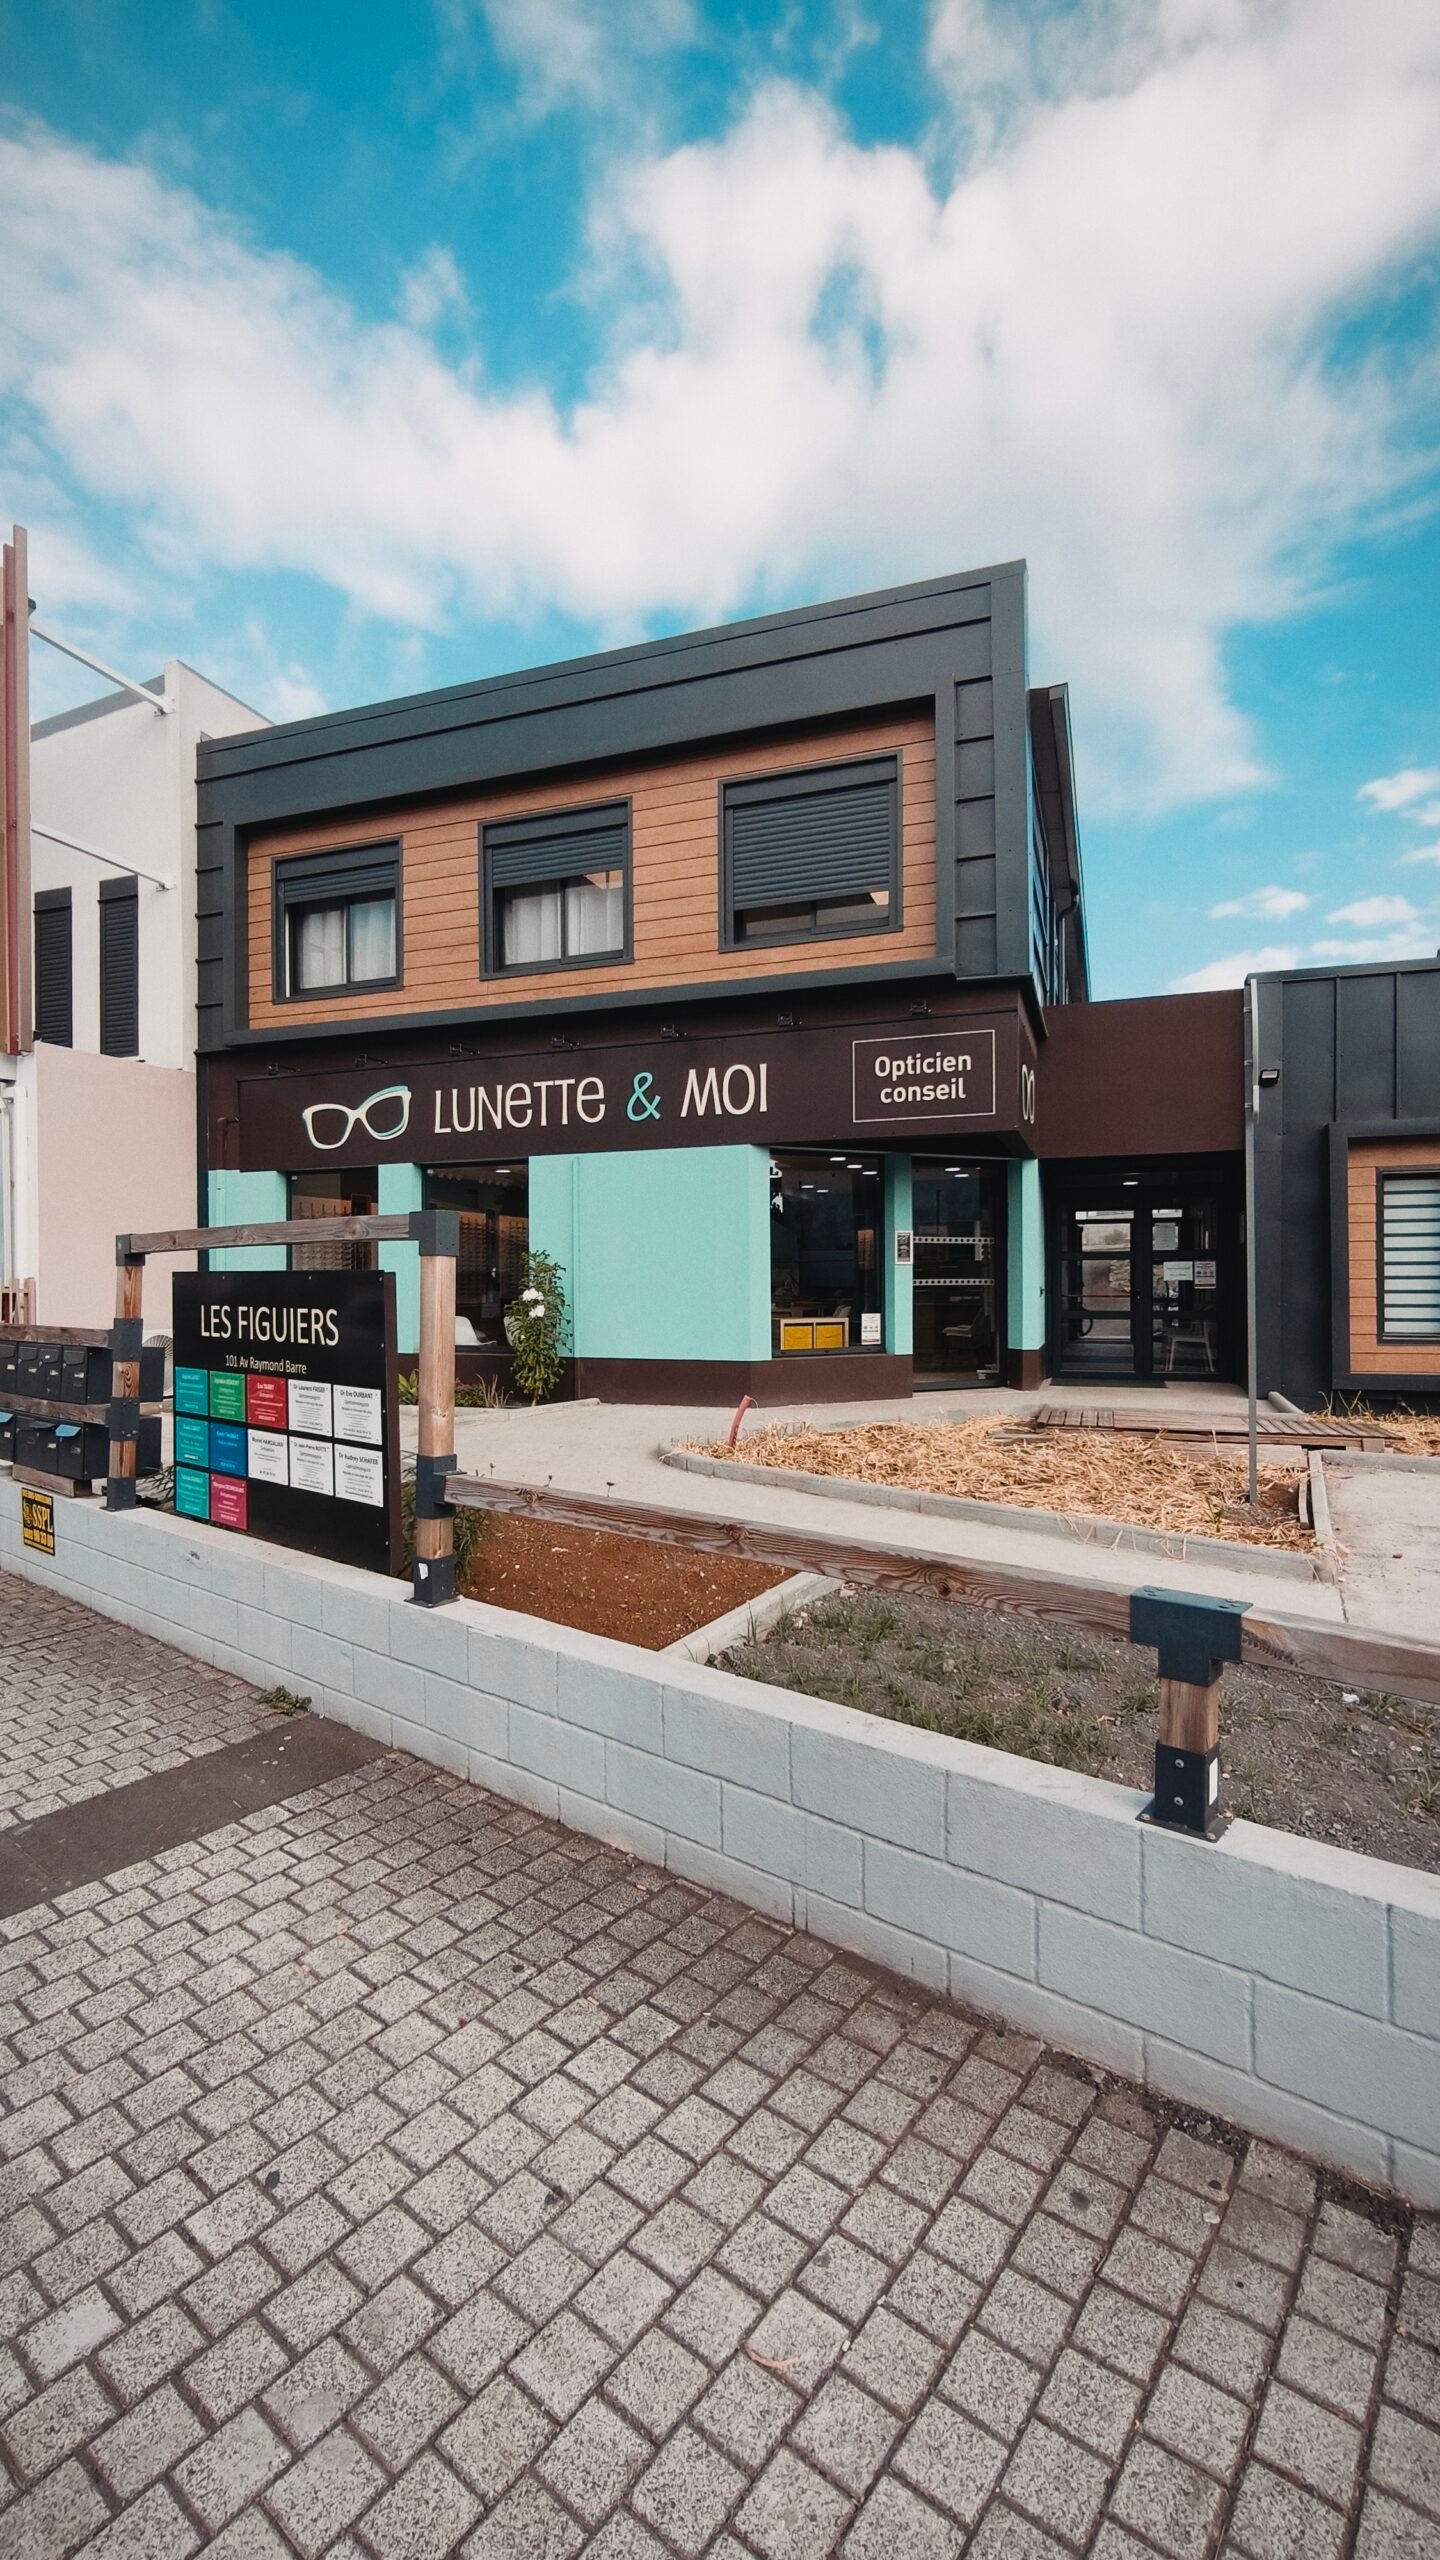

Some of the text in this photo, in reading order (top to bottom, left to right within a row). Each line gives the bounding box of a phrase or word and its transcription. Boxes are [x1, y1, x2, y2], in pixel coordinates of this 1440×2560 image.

[874, 1051, 972, 1082] Opticien
[626, 1071, 661, 1122] &
[680, 1063, 767, 1118] MOI
[880, 1077, 966, 1104] conseil
[201, 1304, 339, 1346] LES FIGUIERS
[225, 1354, 307, 1374] 101 Av Raymond Barre
[32, 1503, 53, 1533] SSPL
